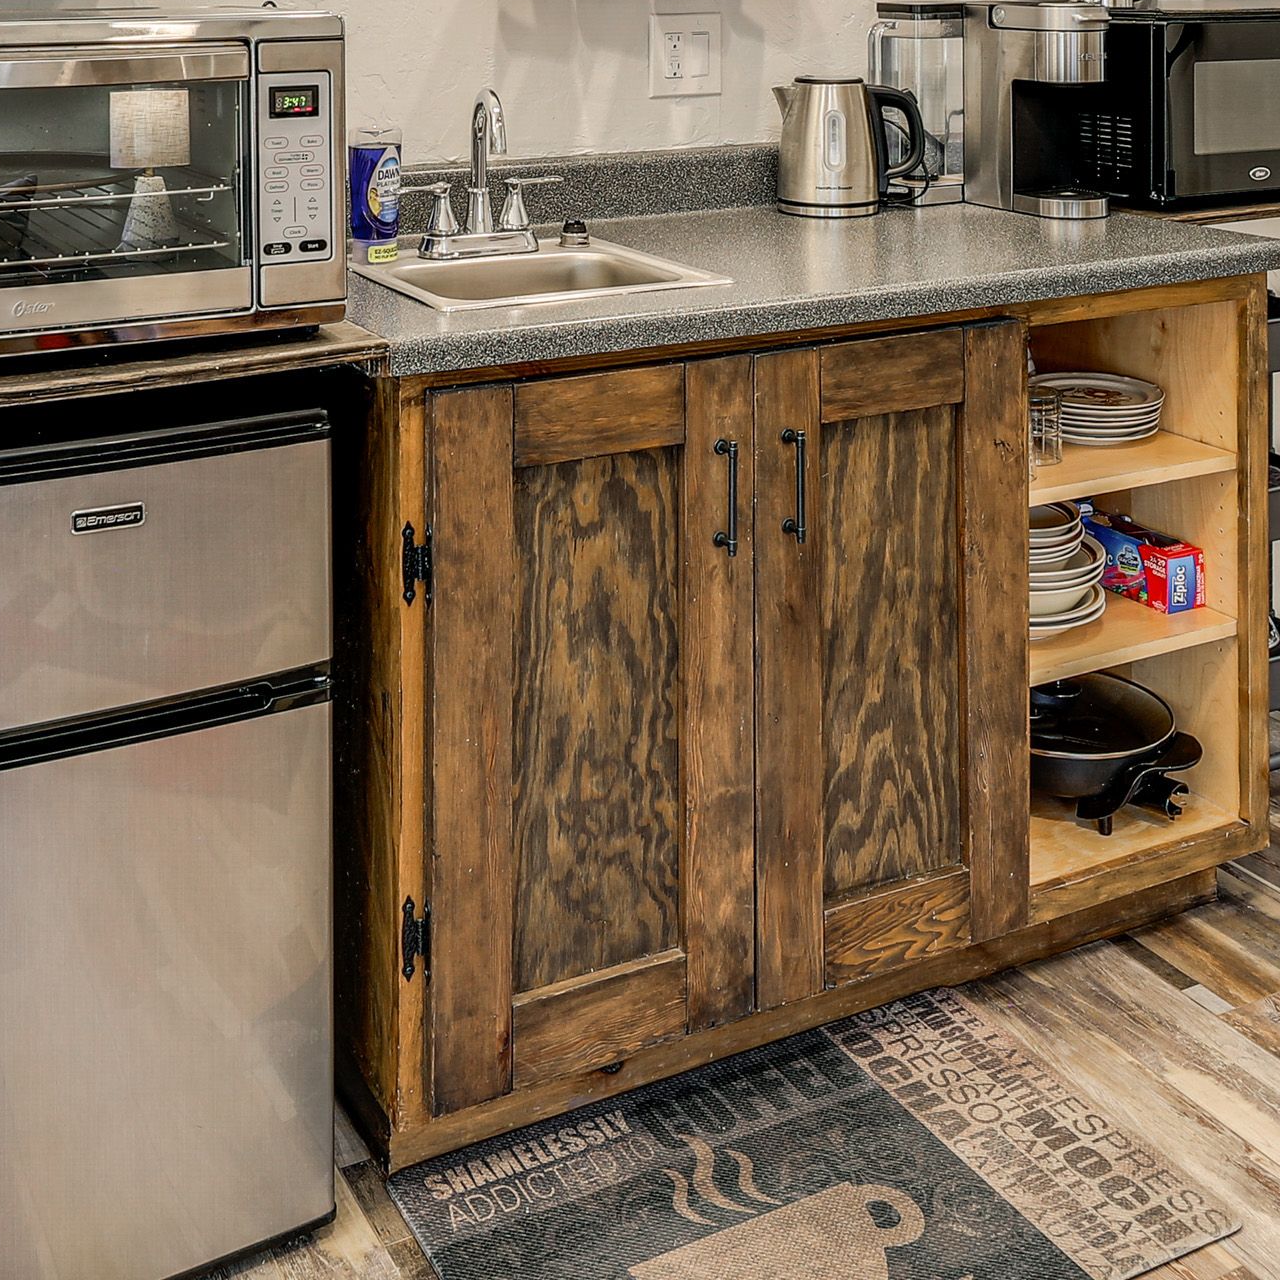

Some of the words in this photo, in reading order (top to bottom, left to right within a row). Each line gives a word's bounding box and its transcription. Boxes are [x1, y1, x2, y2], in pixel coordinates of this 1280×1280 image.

[11, 300, 56, 318] Oster
[86, 511, 141, 526] Emerson
[1173, 566, 1188, 605] Ziploc
[423, 1110, 634, 1200] SHAMELESSLY
[448, 1150, 619, 1232] ADDICTED
